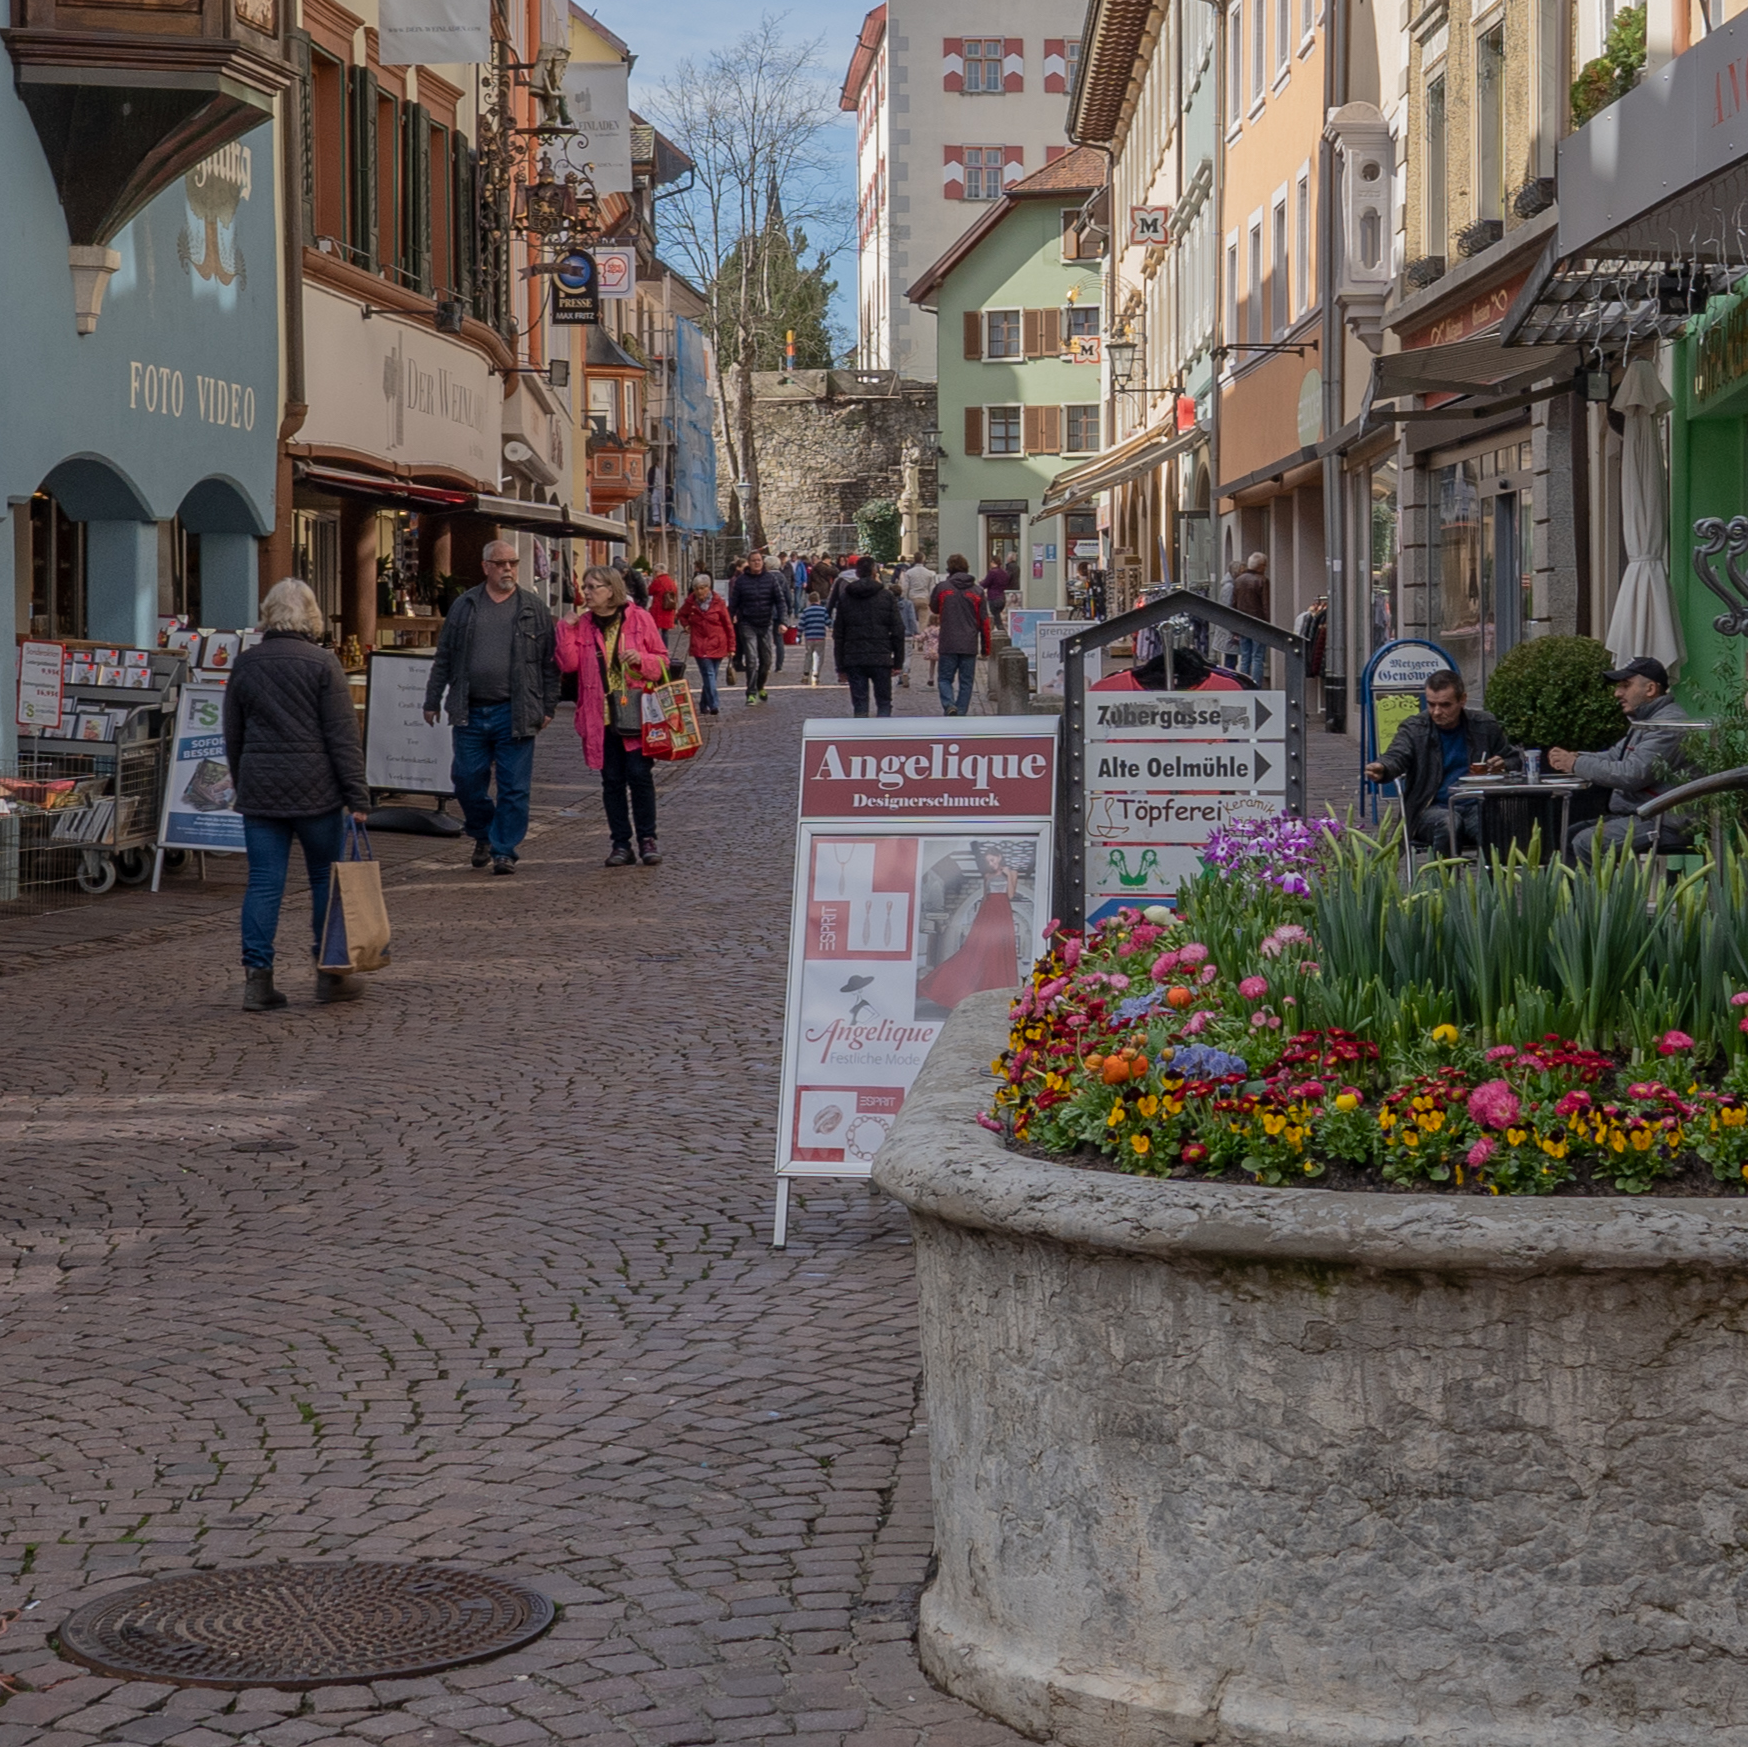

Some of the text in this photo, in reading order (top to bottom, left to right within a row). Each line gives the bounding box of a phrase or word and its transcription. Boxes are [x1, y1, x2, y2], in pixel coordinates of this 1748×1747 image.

[1139, 217, 1159, 234] M
[558, 297, 593, 308] PRESSE
[1080, 345, 1094, 356] M
[129, 360, 255, 431] FOTO VIDEO
[183, 745, 223, 759] BESSER
[810, 743, 1047, 790] Angelique
[1098, 756, 1249, 778] Alte Oelmühle
[852, 793, 1000, 810] Designerschmuck
[1116, 798, 1222, 827] Töpferei
[805, 1018, 934, 1065] Angelique
[830, 1052, 920, 1066] Festliche Mode
[859, 1096, 896, 1107] ESPRIT
